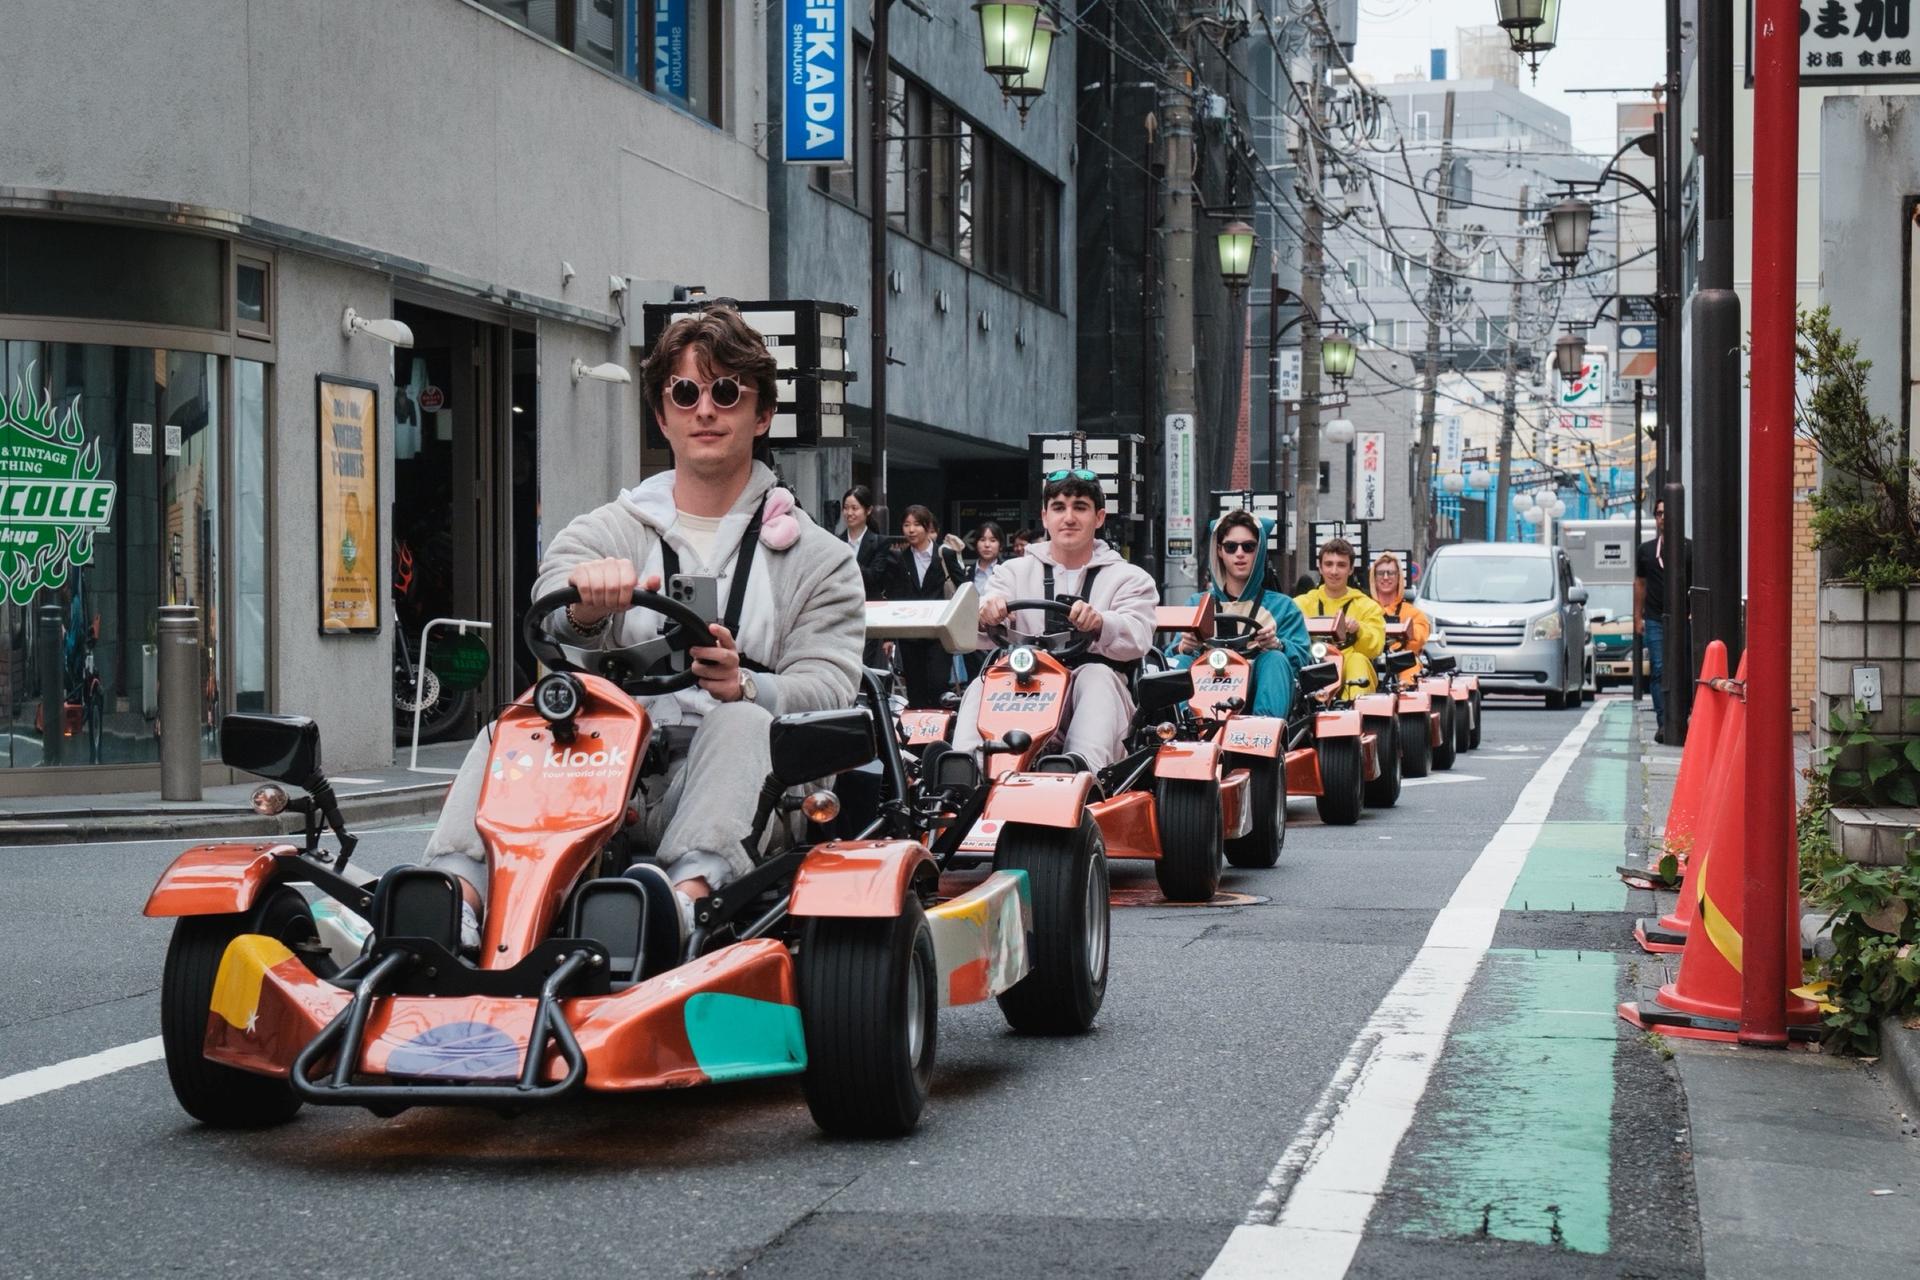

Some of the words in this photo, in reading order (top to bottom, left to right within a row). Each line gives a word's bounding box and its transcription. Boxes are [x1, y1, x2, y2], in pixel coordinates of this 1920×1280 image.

[1800, 0, 1910, 42] ま加
[793, 23, 804, 85] SHINJUKU
[1806, 51, 1843, 67] お酒
[1858, 49, 1911, 66] 食事処
[806, 0, 835, 150] FKADA
[12, 446, 68, 465] VINTAGE
[0, 460, 43, 473] THING
[0, 485, 112, 518] COLLE
[0, 528, 39, 545] kyo
[986, 692, 1057, 701] JAPAN
[1198, 684, 1239, 692] KART
[991, 702, 1050, 712] KART
[1230, 732, 1272, 749] 風神
[543, 746, 628, 768] klook
[543, 771, 565, 779] Your
[567, 770, 594, 778] world
[596, 769, 607, 777] of
